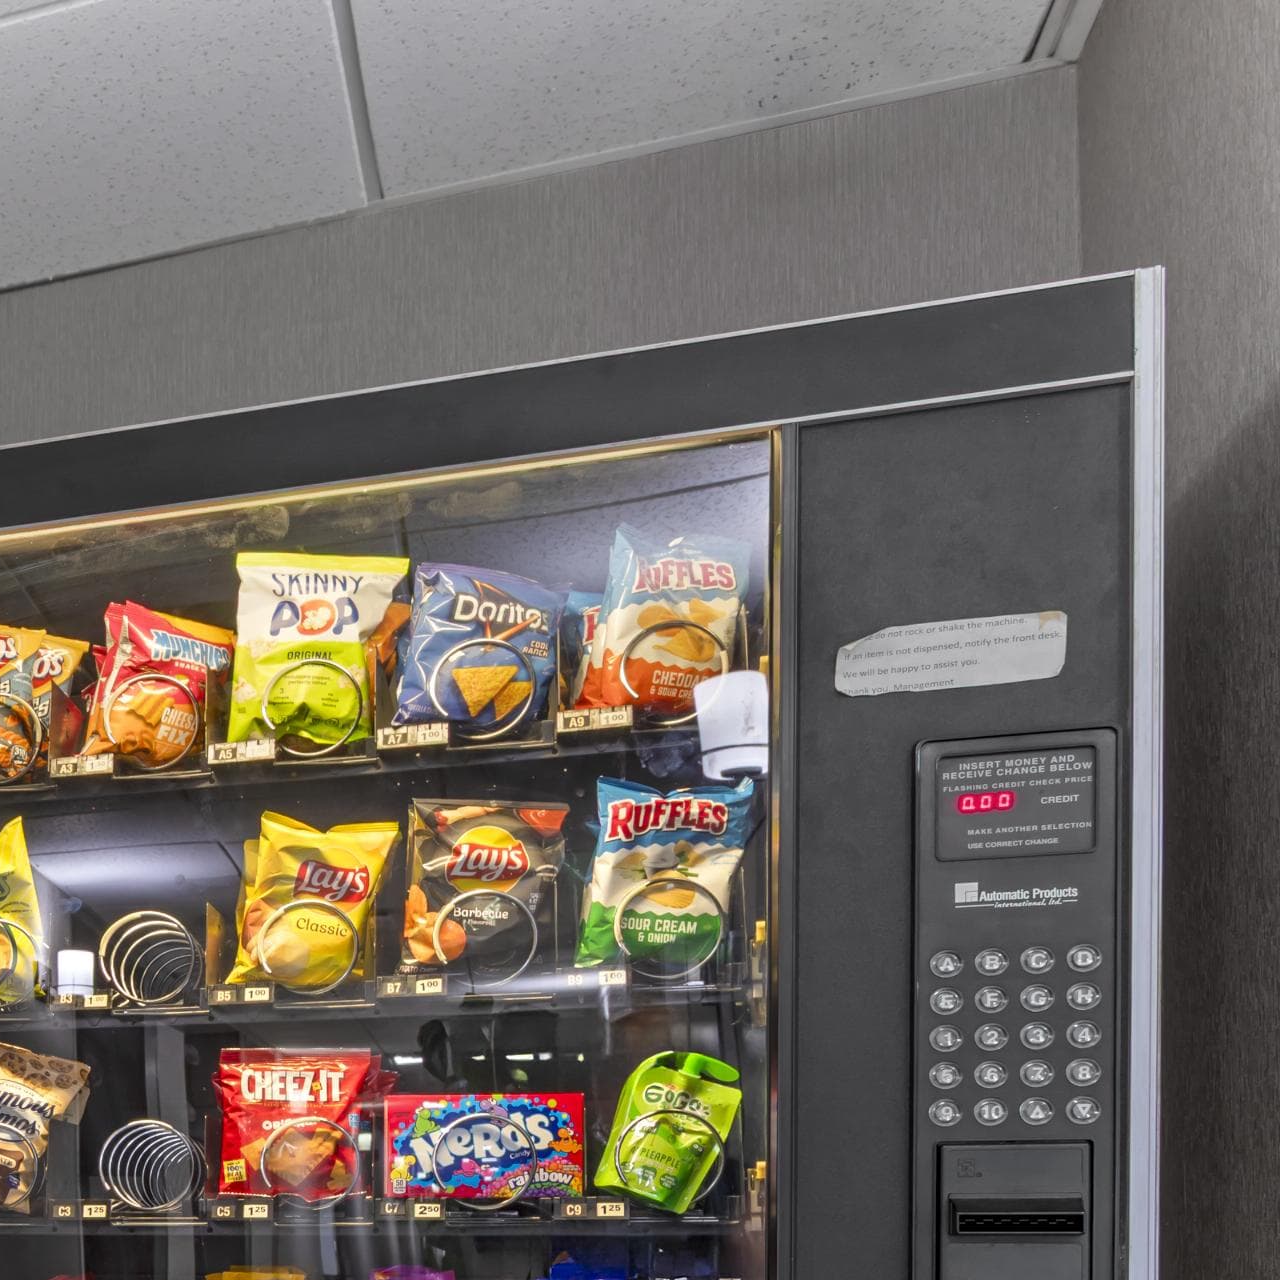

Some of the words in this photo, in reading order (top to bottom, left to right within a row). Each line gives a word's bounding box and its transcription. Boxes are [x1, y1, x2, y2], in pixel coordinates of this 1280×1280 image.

[271, 572, 364, 597] SKINNY
[270, 596, 360, 637] POP
[453, 594, 549, 632] Doritos
[888, 629, 903, 639] not
[905, 626, 924, 637] rock
[926, 627, 936, 635] or
[938, 622, 966, 633] shake
[968, 620, 983, 630] the
[985, 616, 1028, 628] machine.
[844, 652, 851, 661] If
[864, 649, 885, 659] item
[886, 648, 894, 657] is
[895, 646, 911, 656] not
[914, 639, 963, 655] dispensed,
[964, 637, 992, 650] notify
[994, 636, 1010, 646] the
[1012, 633, 1037, 643] front
[1038, 630, 1064, 640] desk.
[287, 651, 333, 660] ORIGINAL
[842, 670, 858, 679] We
[859, 667, 875, 678] will
[877, 666, 889, 676] be
[890, 663, 919, 676] happy
[921, 663, 931, 672] to
[933, 659, 959, 670] assist
[960, 658, 981, 668] you.
[893, 679, 955, 692] Management
[569, 716, 585, 728] A9
[156, 728, 189, 746] FIX
[387, 732, 403, 745] A7
[59, 764, 73, 774] A3
[959, 760, 1001, 771] INSERT
[1005, 757, 1047, 768] MONEY
[1050, 754, 1076, 763] AND
[942, 769, 992, 781] RECEIVE
[996, 765, 1045, 776] CHANGE
[1050, 761, 1093, 772] BELOW
[943, 783, 989, 793] FLASHING
[992, 780, 1026, 789] CREDIT
[1029, 778, 1062, 787] CHECK
[1064, 775, 1093, 784] PRICE
[1040, 794, 1080, 805] CREDIT
[605, 797, 729, 842] RUFFLES
[967, 827, 993, 836] MAKE
[995, 824, 1038, 834] ANOTHER
[1040, 821, 1092, 831] SELECTION
[967, 842, 984, 850] USE
[985, 839, 1023, 848] CORRECT
[1024, 837, 1059, 846] CHANGE
[451, 843, 524, 882] Lay's
[297, 861, 368, 902] Lay's
[979, 888, 1030, 902] Automatic
[1032, 886, 1078, 899] Products
[453, 905, 509, 921] Barbecue
[296, 916, 349, 938] Classic
[621, 917, 651, 931] SOUR
[655, 919, 697, 934] CREAM
[647, 932, 677, 943] ONION
[940, 957, 955, 972] A
[568, 974, 583, 985] B9
[386, 982, 401, 993] B7
[217, 990, 231, 1001] B5
[981, 1105, 1003, 1119] 10
[509, 1149, 531, 1160] Candy
[507, 1168, 572, 1191] rainbow
[216, 1206, 231, 1217] C5
[384, 1203, 399, 1214] C7
[566, 1204, 582, 1216] C9
